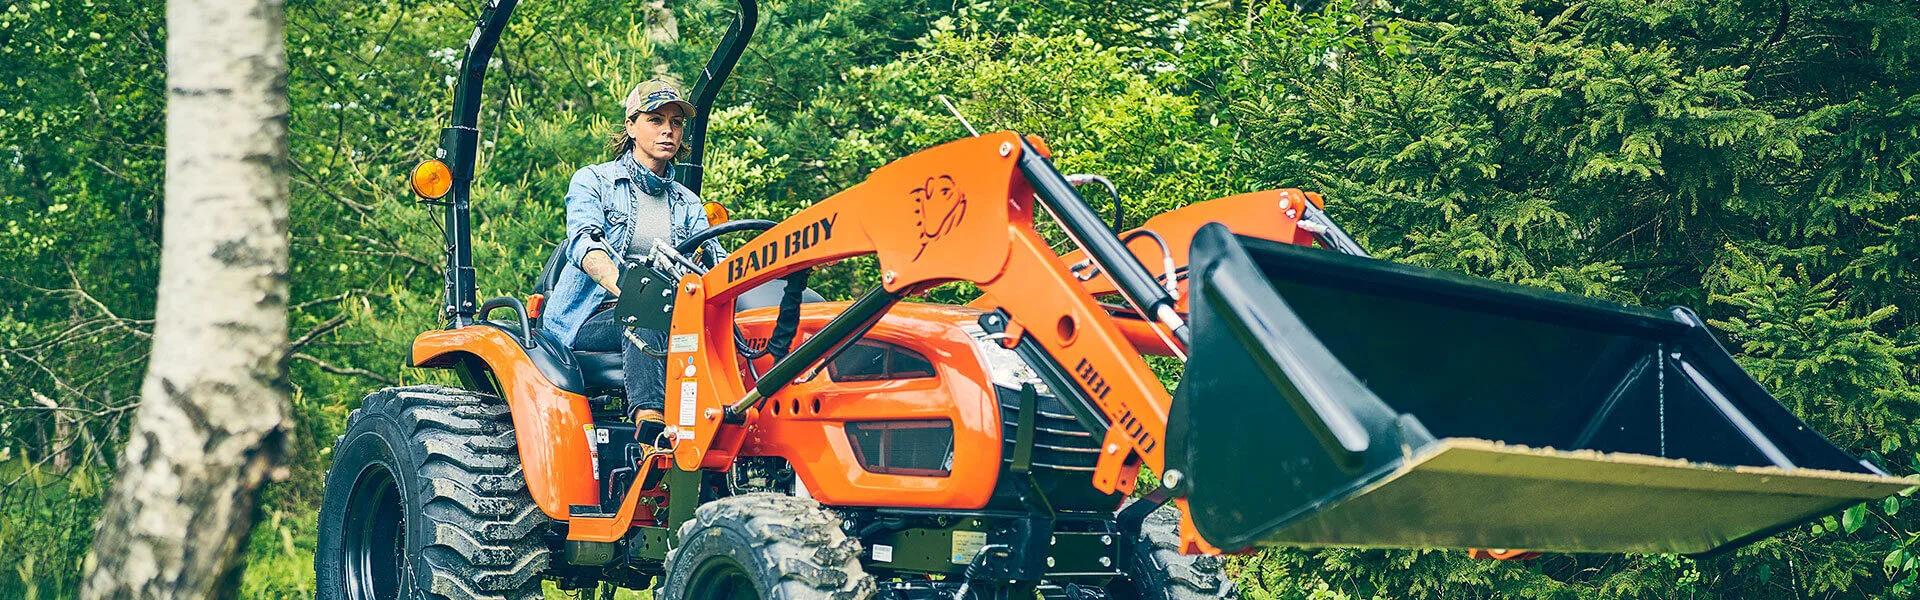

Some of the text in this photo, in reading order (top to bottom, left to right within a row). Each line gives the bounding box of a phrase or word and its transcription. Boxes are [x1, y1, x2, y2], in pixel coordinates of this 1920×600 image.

[728, 212, 838, 284] BAD BOY
[1075, 358, 1156, 453] BBL 300
